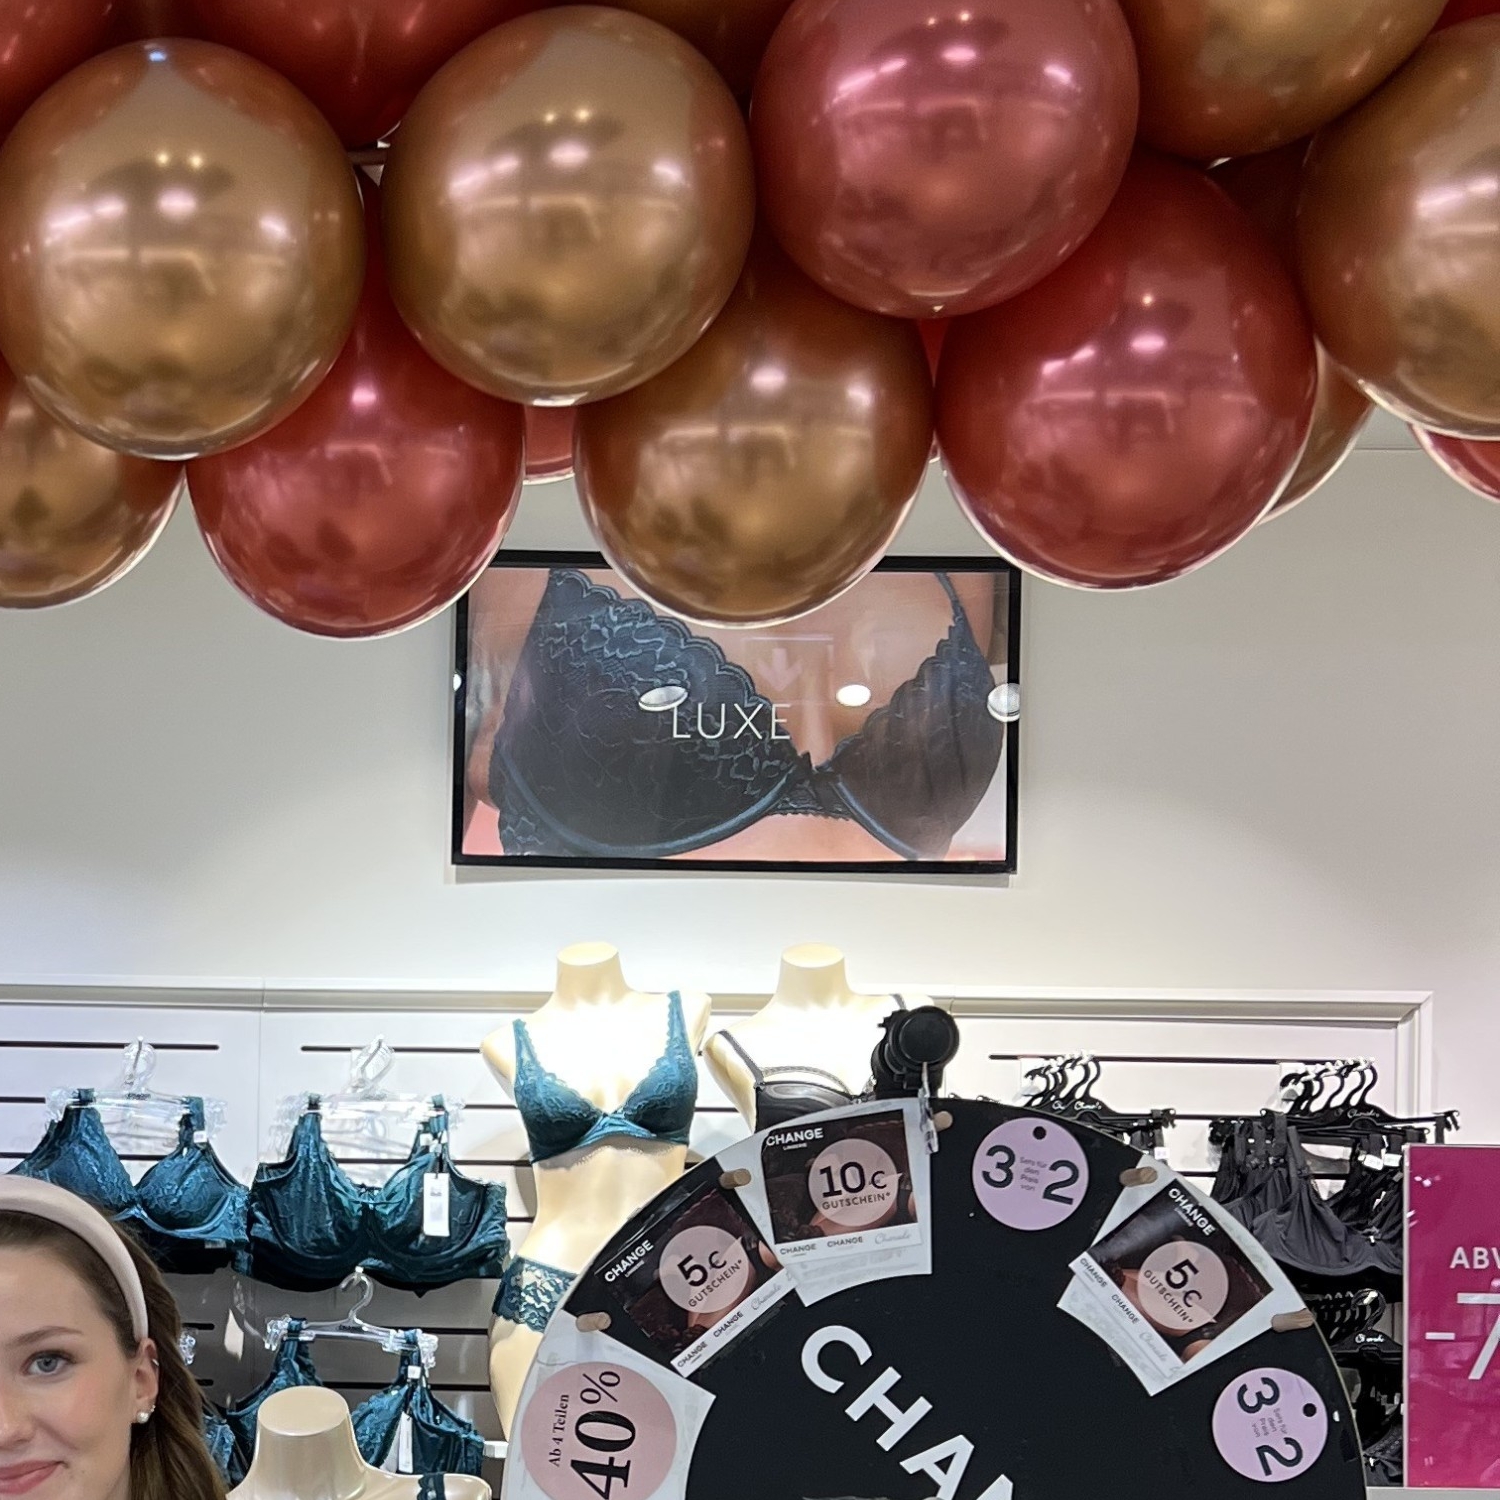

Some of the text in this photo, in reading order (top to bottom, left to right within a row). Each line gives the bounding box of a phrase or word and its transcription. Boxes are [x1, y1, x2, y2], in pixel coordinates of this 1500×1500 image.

[673, 703, 791, 741] LUXE
[765, 1127, 824, 1147] CHANGE
[982, 1144, 1015, 1188] 3
[1042, 1159, 1079, 1205] 2
[1168, 1187, 1216, 1236] CHANGE
[604, 1239, 654, 1283] CHANGE
[1450, 1247, 1500, 1269] AB
[1237, 1377, 1280, 1414] 3
[548, 1394, 569, 1467] Ab 4 Teilen
[570, 1370, 636, 1500] 40%
[1255, 1437, 1303, 1476] 2
